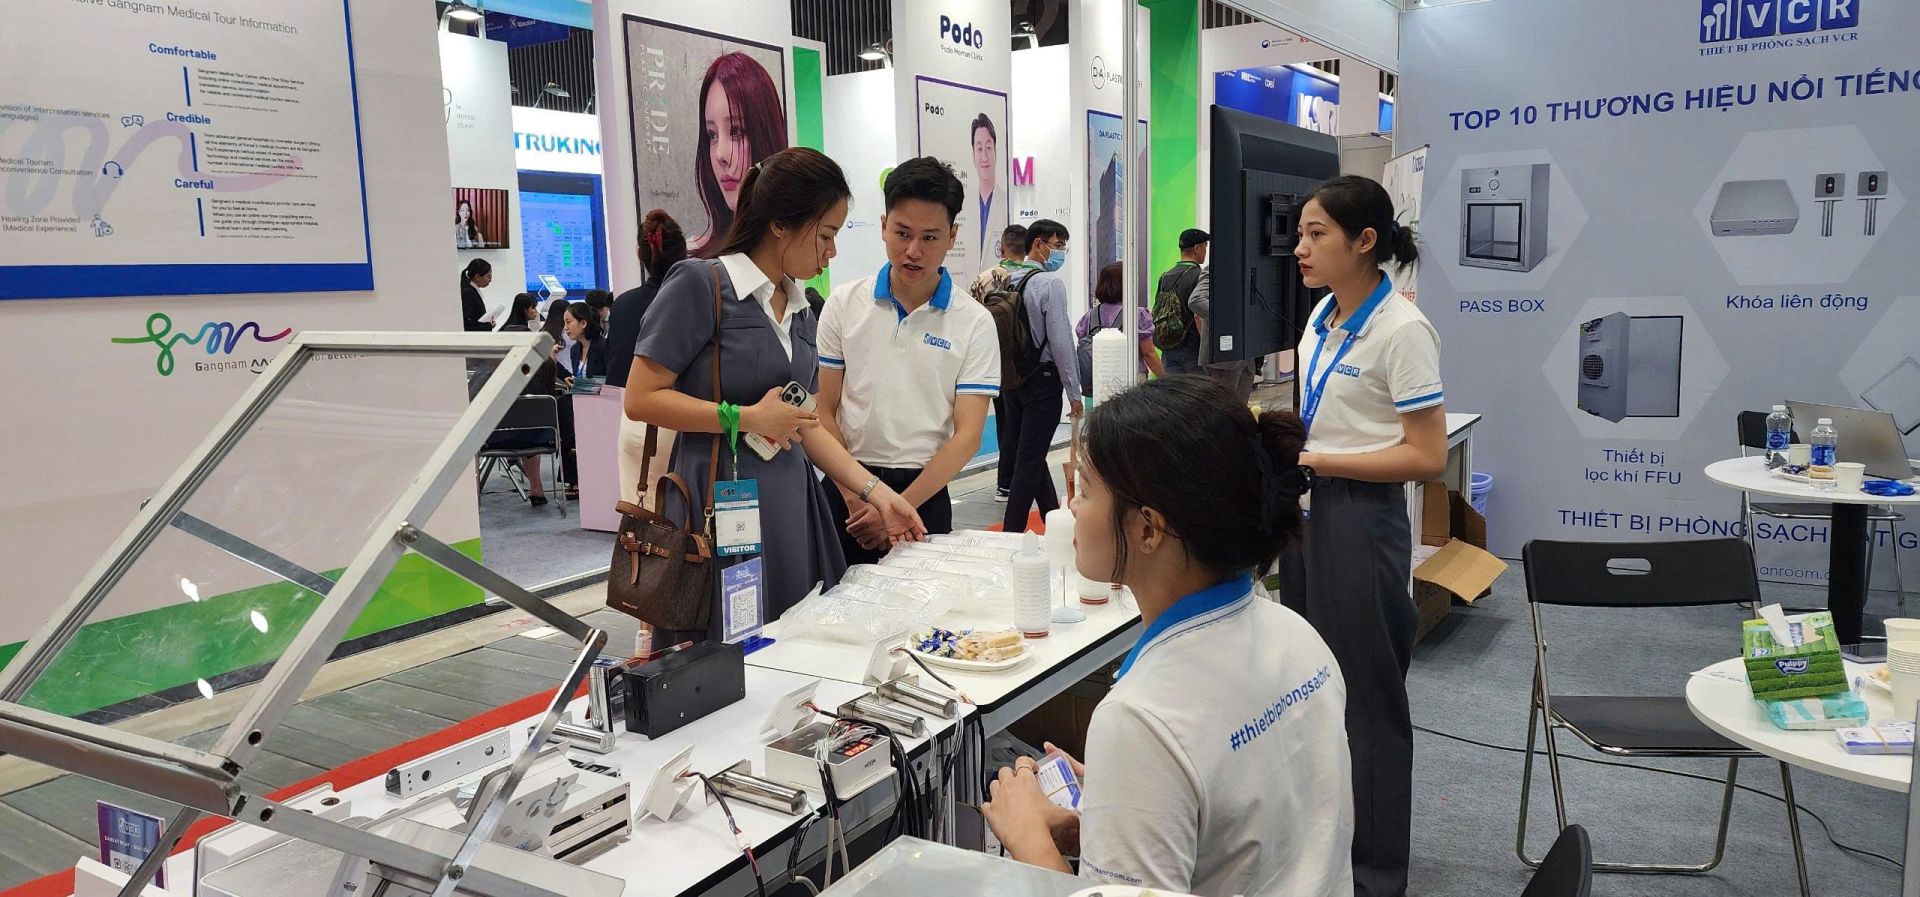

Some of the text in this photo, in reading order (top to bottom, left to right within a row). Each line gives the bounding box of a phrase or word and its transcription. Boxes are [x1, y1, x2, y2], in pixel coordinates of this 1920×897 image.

[107, 0, 164, 14] Gangnam
[167, 5, 211, 21] Medical
[213, 12, 237, 25] Tour
[239, 16, 297, 34] Information
[940, 15, 983, 49] Podo
[149, 43, 217, 60] Comfortable
[1699, 33, 1858, 56] THIẾT BỊ PHÒNG SẠCH VCR
[925, 102, 944, 116] Podo
[1449, 108, 1501, 131] TOP
[1510, 105, 1537, 126] 10
[1546, 91, 1674, 122] THƯƠNG
[1685, 83, 1757, 112] HIỆU
[1768, 73, 1824, 102] NỔI
[0, 113, 39, 121] anguages)
[33, 106, 81, 116] interpretation
[82, 111, 110, 119] services
[166, 112, 211, 124] Credible
[26, 158, 54, 166] Tourism
[49, 167, 94, 176] Consultation
[174, 178, 213, 189] Careful
[1, 216, 29, 224] Healing
[1460, 299, 1545, 312] PASS BOX
[1726, 294, 1868, 311] Khóa liên động
[930, 336, 951, 350] VCR
[195, 360, 247, 373] Gangnam
[1338, 364, 1360, 378] VCR
[1603, 448, 1664, 467] Thiết bị
[1585, 468, 1681, 485] lọc khí FFU
[1558, 508, 1623, 529] THIẾT
[1630, 514, 1650, 534] BỊ
[1659, 514, 1748, 538] PHÒNG
[1756, 522, 1827, 543] SẠCH
[723, 544, 756, 554] VISITOR
[1778, 658, 1808, 671] Pulppy
